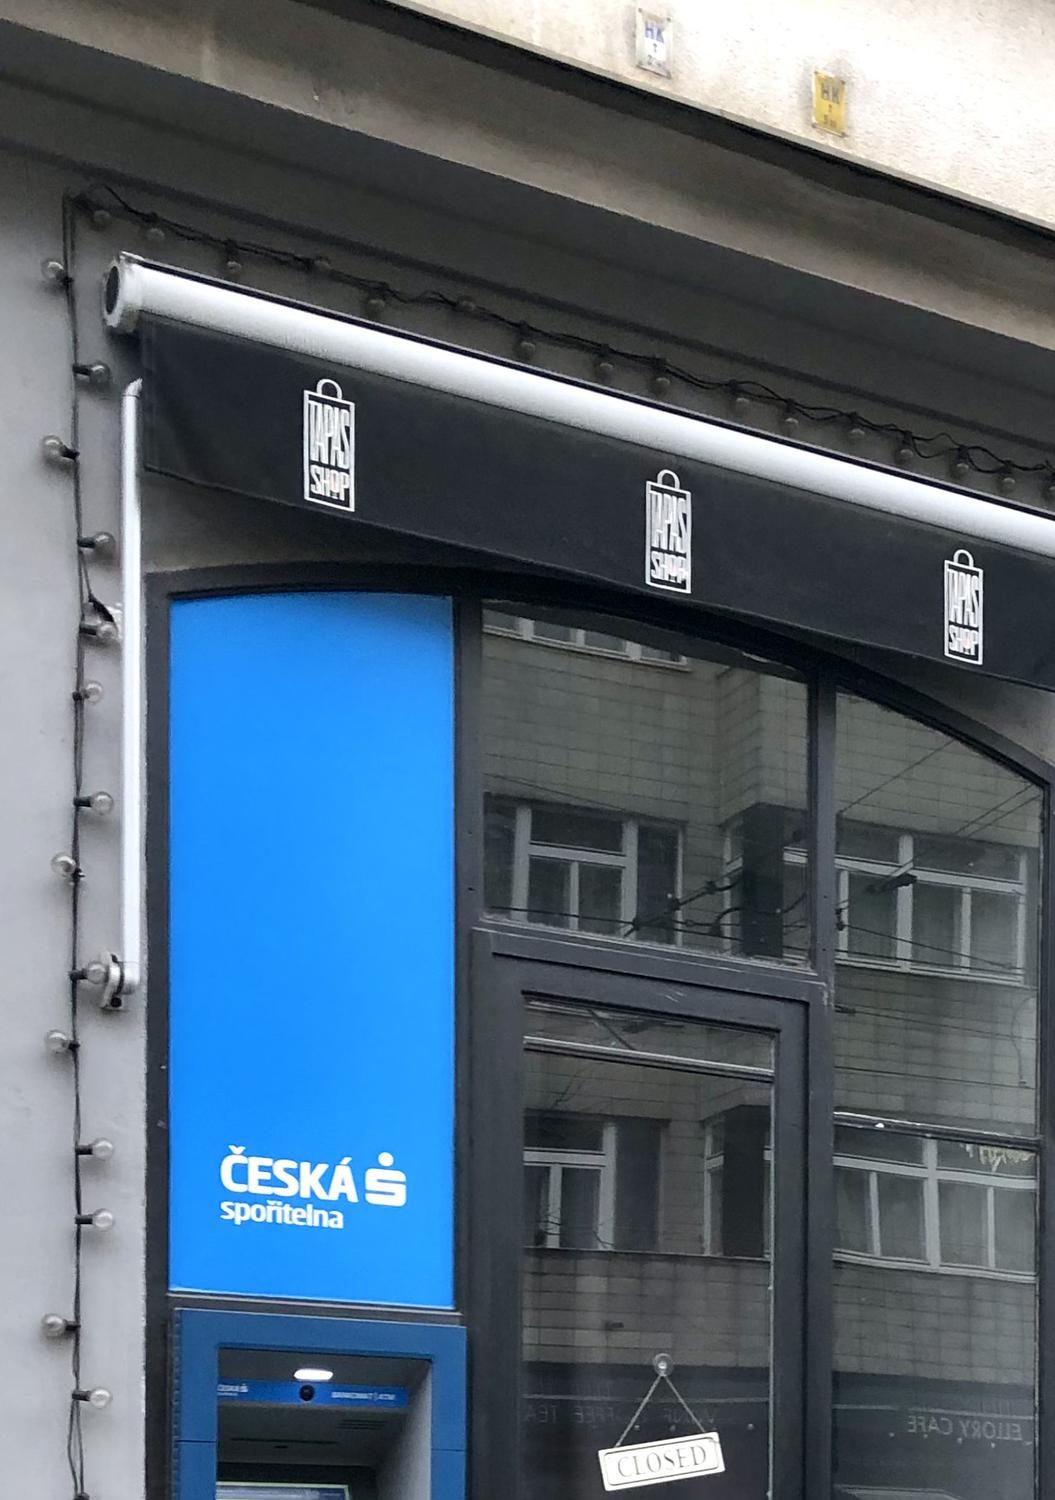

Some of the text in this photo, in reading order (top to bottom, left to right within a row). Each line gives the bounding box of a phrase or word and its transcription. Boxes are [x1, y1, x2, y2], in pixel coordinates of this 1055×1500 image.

[308, 401, 350, 468] TAPAS
[310, 466, 350, 500] SHOP
[650, 491, 688, 553] TAPAS
[651, 551, 688, 584] SHOP
[947, 569, 980, 627] TAPAS
[949, 625, 978, 656] SHOP
[220, 1145, 359, 1203] ČESKÁ
[220, 1199, 345, 1229] spořitelna
[617, 1445, 707, 1478] CLOSED
